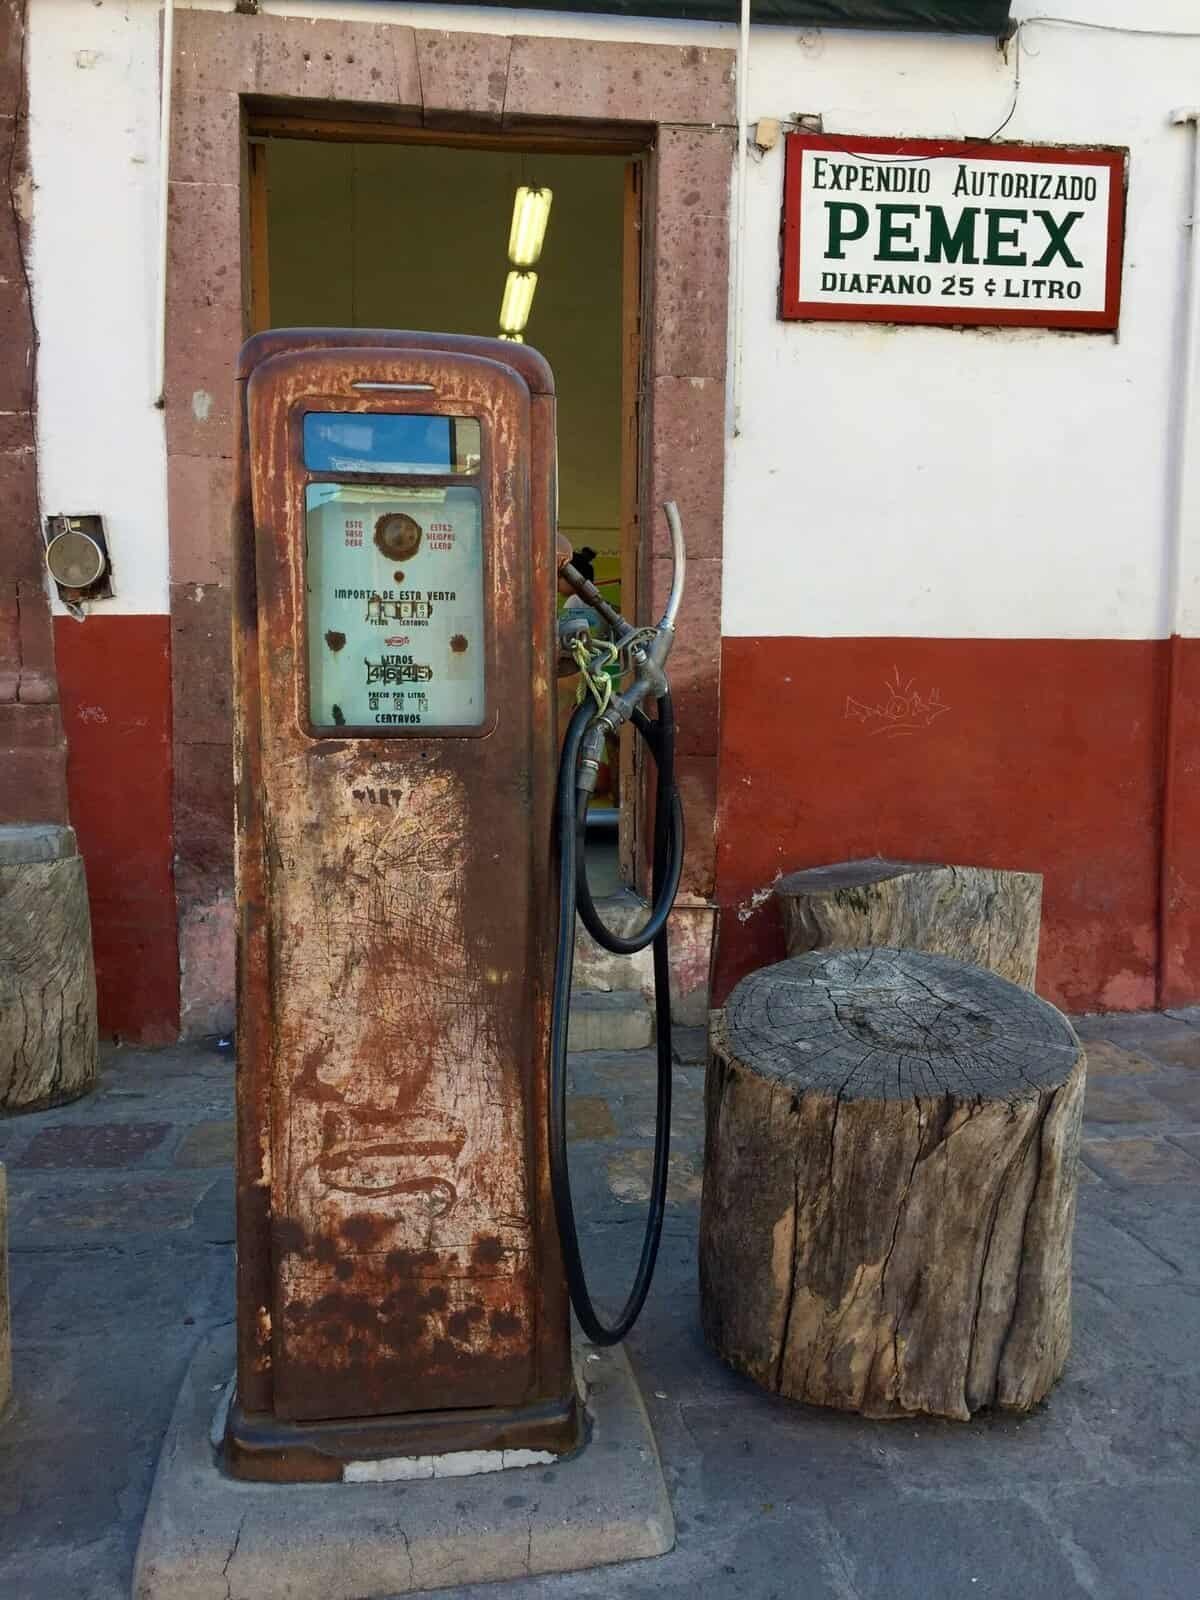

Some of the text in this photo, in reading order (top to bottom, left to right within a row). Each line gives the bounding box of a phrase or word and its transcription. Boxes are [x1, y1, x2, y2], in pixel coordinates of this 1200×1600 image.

[813, 158, 1097, 201] EXPENDIO AUTORIZADO
[824, 201, 1085, 268] PEMEX
[820, 272, 932, 295] DIAFANO
[941, 276, 974, 296] 25
[1004, 279, 1081, 300] LITRO
[383, 590, 394, 600] DE
[400, 591, 422, 601] ESTA
[427, 591, 456, 601] VENTA
[381, 655, 414, 665] LITROS
[375, 714, 421, 724] CENTAVOS
